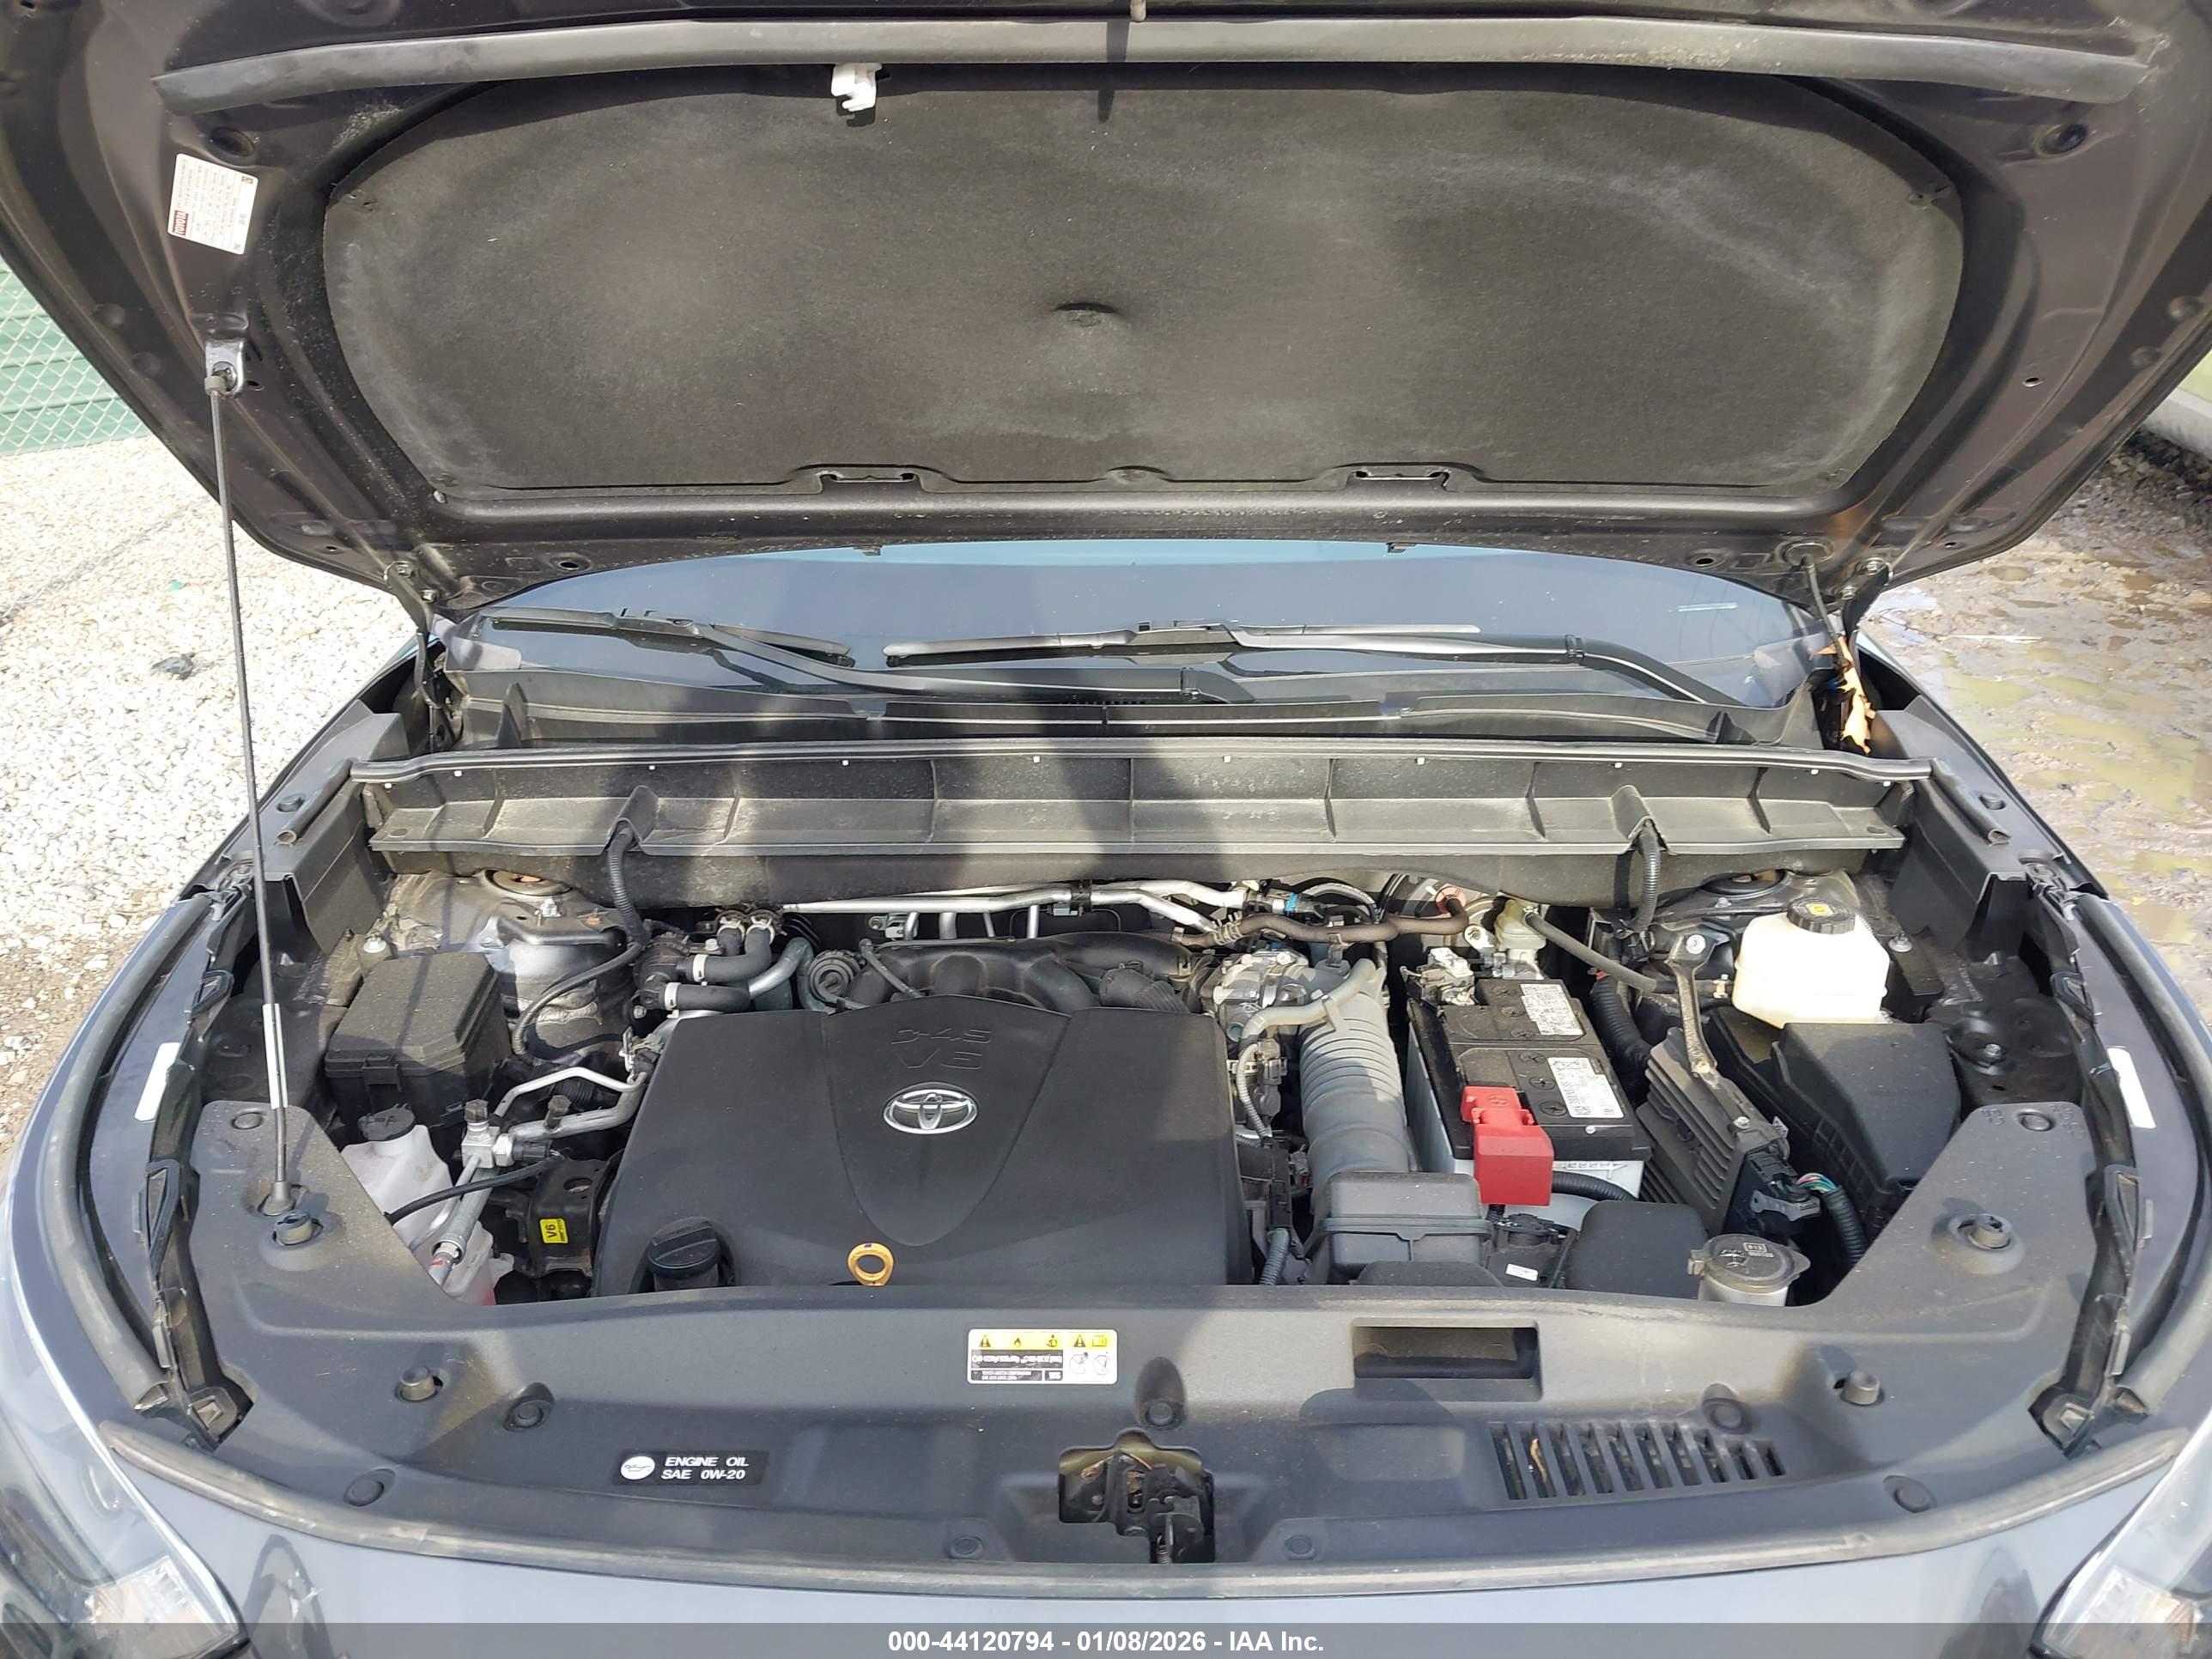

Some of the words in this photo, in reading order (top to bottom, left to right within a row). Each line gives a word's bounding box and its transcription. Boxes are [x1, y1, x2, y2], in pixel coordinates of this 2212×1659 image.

[173, 211, 188, 236] TOYOTA
[893, 1048, 983, 1070] V6
[546, 1224, 557, 1238] V6
[665, 1456, 720, 1467] ENGINE
[726, 1456, 750, 1467] OIL
[660, 1469, 693, 1480] SAE
[700, 1469, 746, 1480] 0W-20
